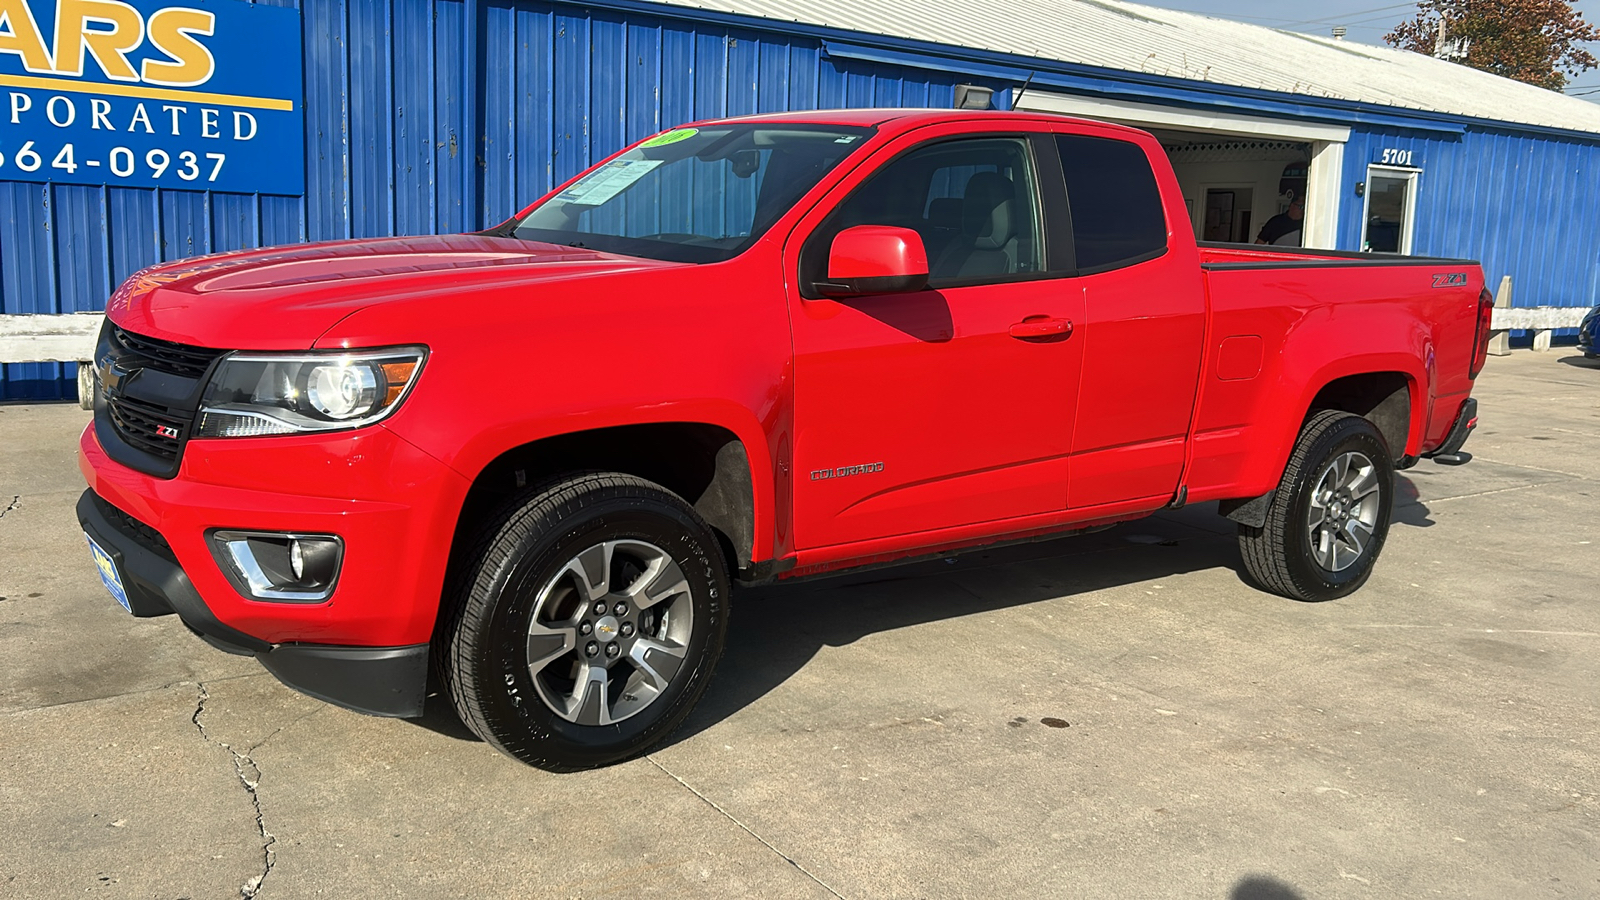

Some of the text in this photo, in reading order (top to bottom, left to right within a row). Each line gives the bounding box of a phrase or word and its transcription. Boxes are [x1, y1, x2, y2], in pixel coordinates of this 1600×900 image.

[9, 92, 258, 141] PORATED
[0, 140, 226, 182] 64-0937
[1381, 148, 1412, 166] 5701
[1431, 272, 1467, 288] Z71
[155, 424, 179, 440] Z71
[810, 461, 885, 481] COLORADO
